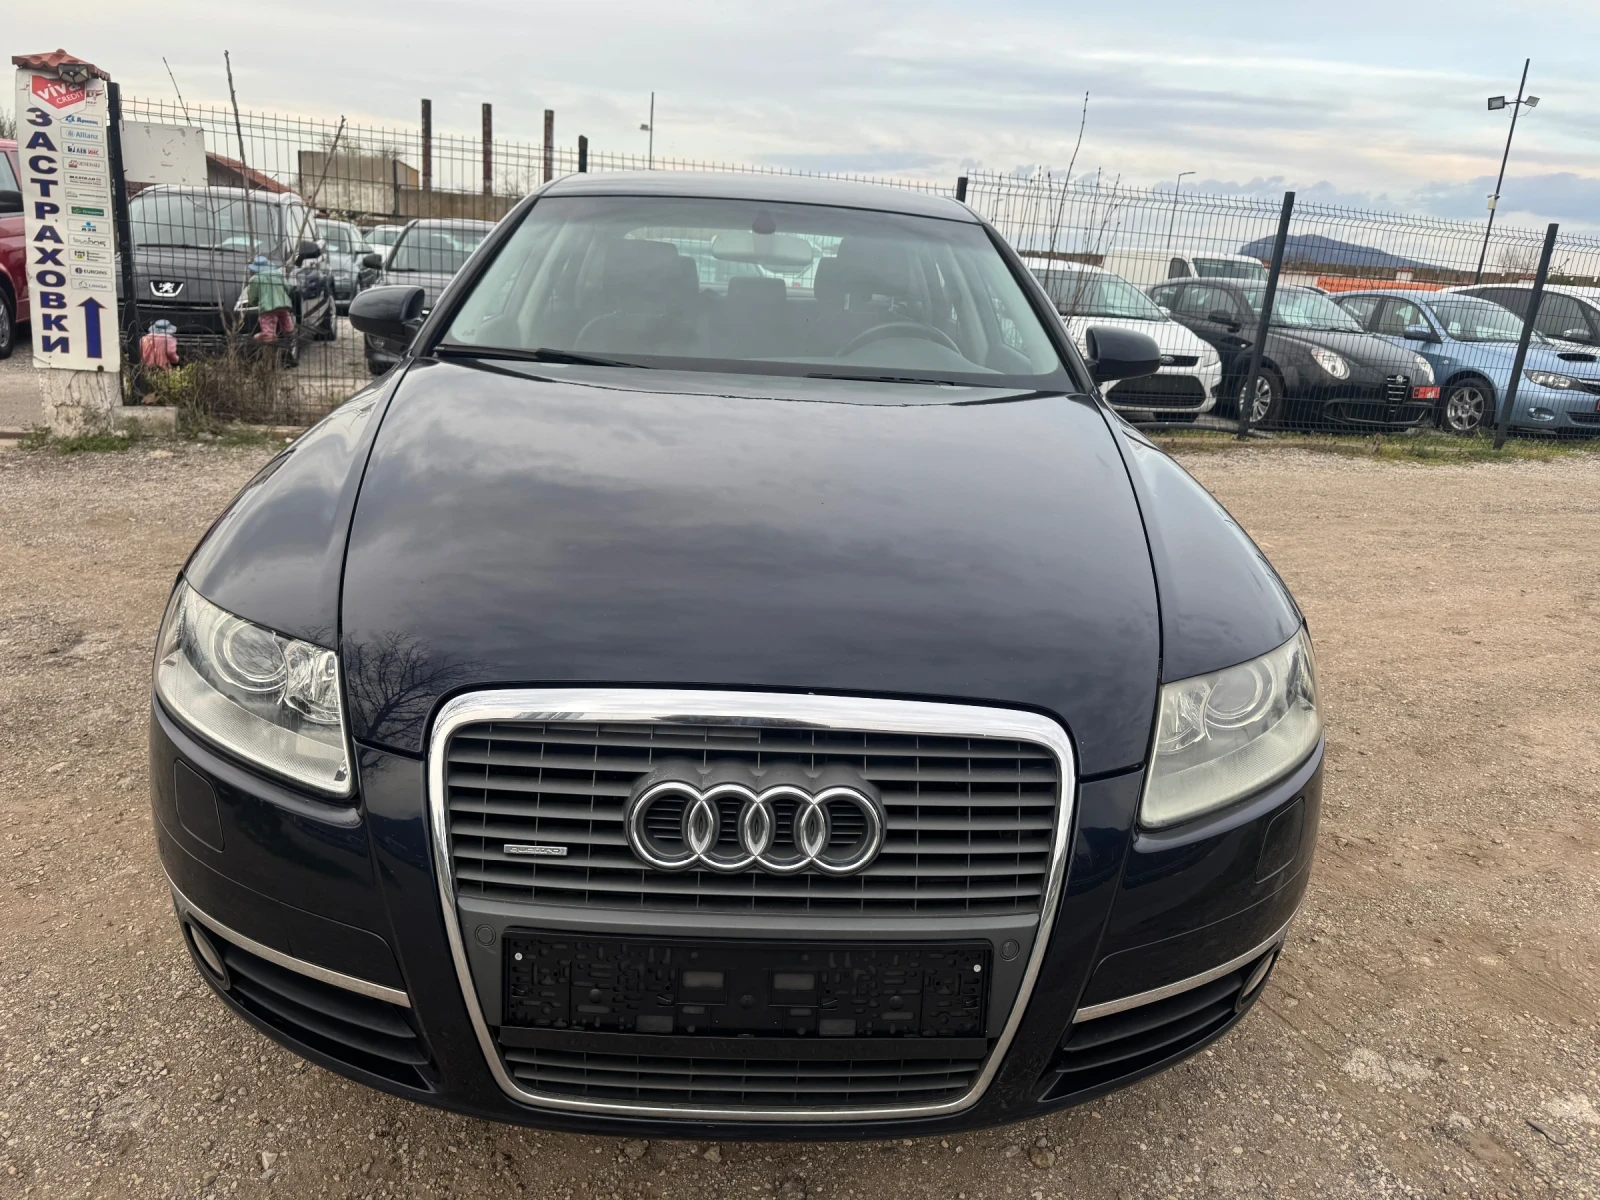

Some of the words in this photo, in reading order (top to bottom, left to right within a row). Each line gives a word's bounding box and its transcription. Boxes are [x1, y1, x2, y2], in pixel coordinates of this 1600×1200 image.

[56, 91, 83, 103] CREDIT
[75, 131, 99, 140] Allianz
[26, 107, 70, 354] ЗАСТРАХОВКИ
